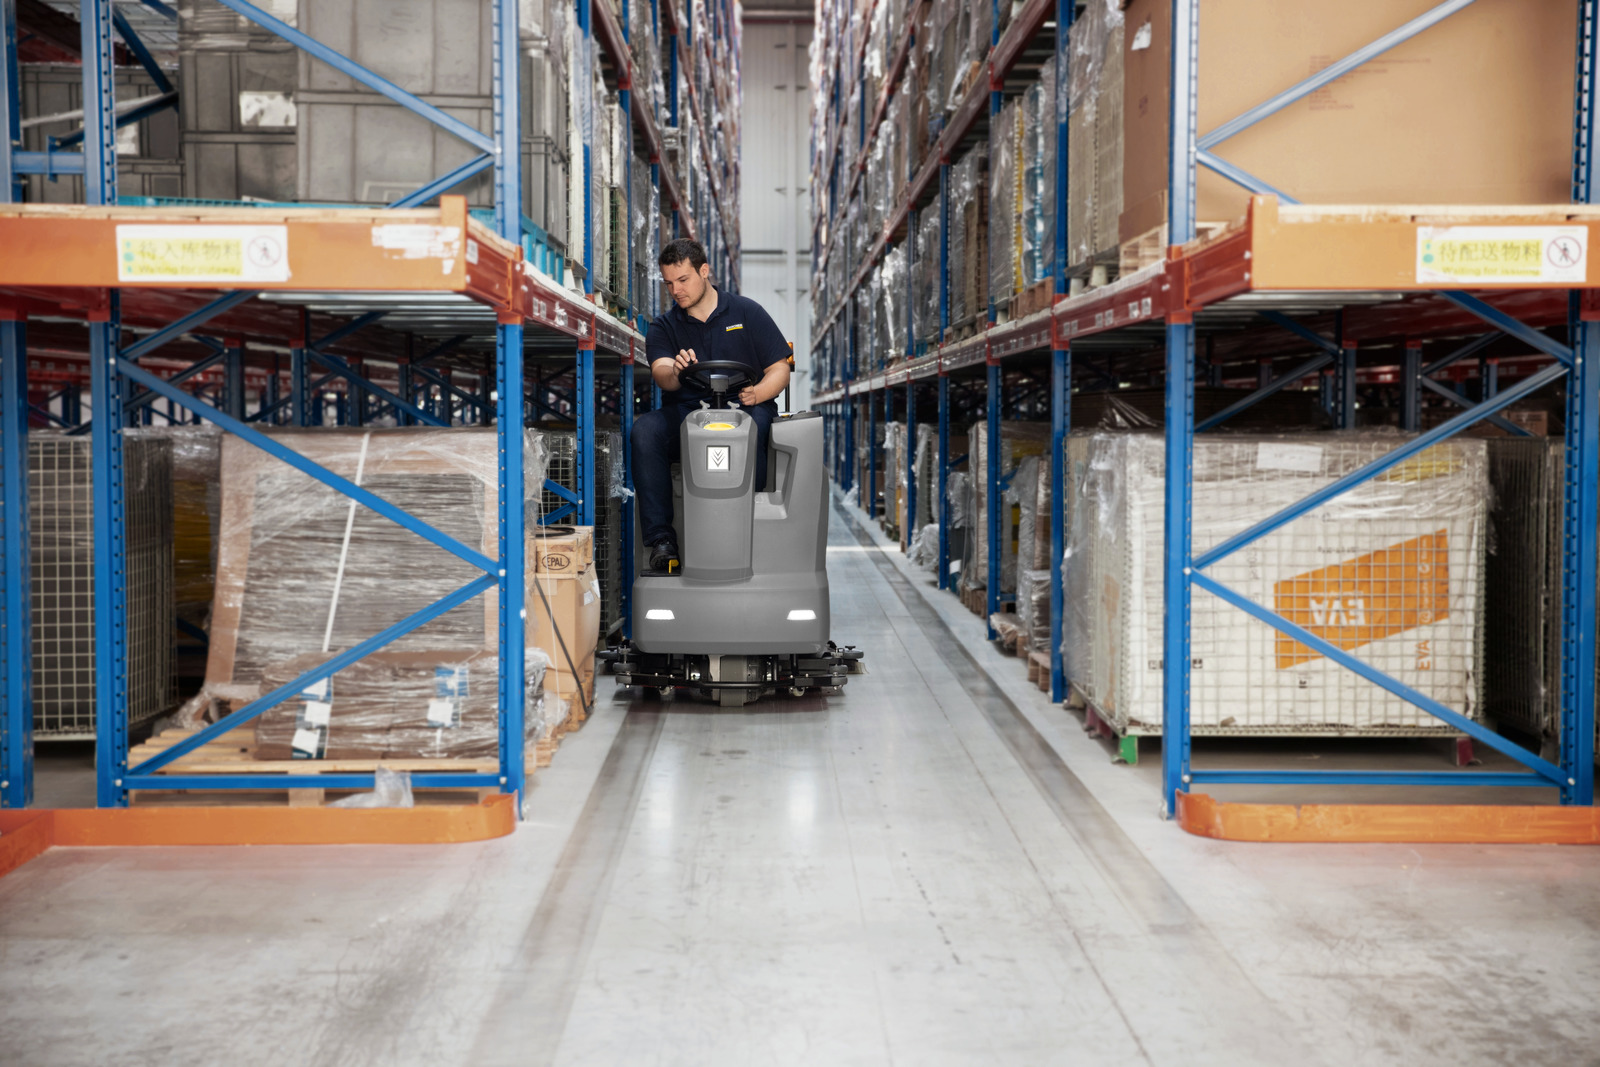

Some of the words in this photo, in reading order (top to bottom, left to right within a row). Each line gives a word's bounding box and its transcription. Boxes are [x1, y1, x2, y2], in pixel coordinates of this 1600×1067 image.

[1440, 241, 1541, 262] 待配送物料
[138, 265, 178, 275] Waiting
[180, 265, 196, 273] for
[1441, 267, 1481, 277] Waiting
[1483, 266, 1498, 275] for
[547, 557, 565, 567] EPAL
[1309, 599, 1365, 625] EVA
[1416, 639, 1431, 671] EVA
